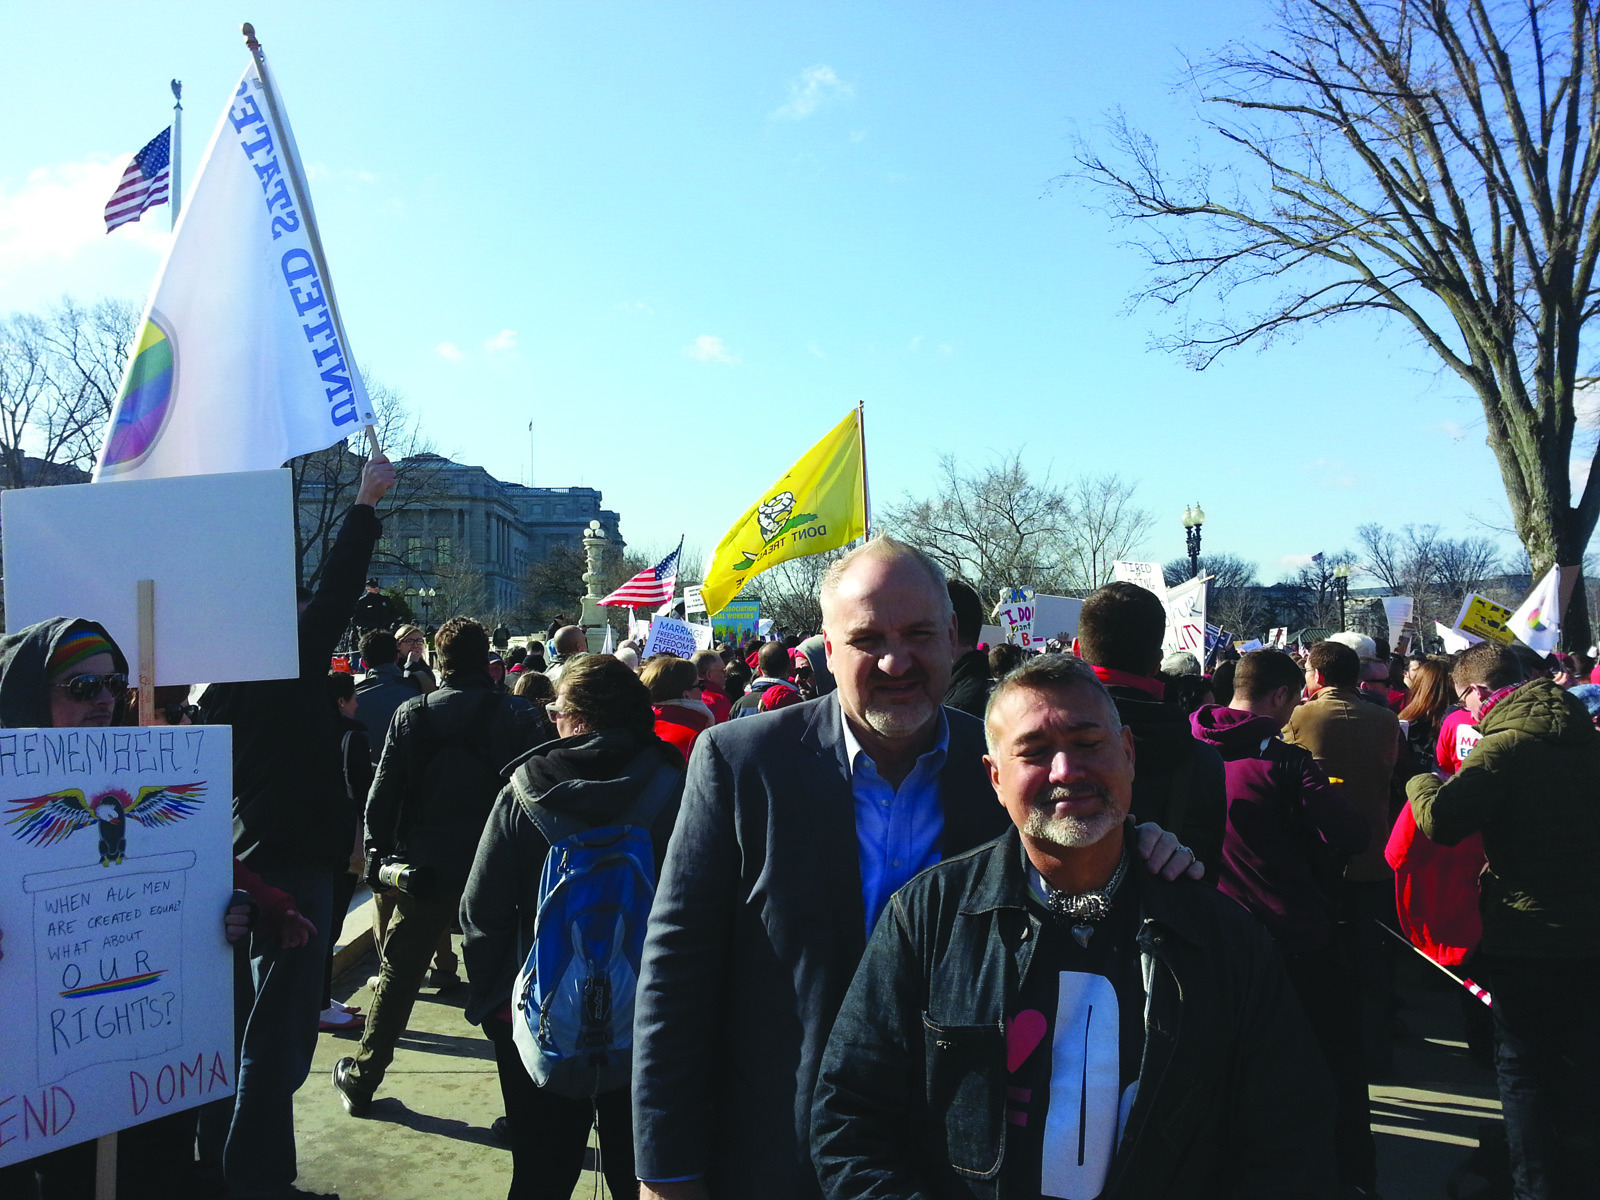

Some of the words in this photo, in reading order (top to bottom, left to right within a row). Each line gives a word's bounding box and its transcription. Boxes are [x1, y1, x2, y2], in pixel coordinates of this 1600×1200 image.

[1121, 562, 1152, 573] TIRED
[655, 636, 688, 650] FREEDOM
[656, 630, 686, 642] FREEDOM
[660, 621, 704, 639] MARRIAGE
[652, 643, 693, 661] EVERYO
[45, 892, 91, 914] WHEN
[106, 887, 136, 902] ALL
[143, 880, 171, 895] MEN
[47, 920, 77, 937] ARE
[88, 909, 141, 929] CREATED
[150, 900, 181, 916] EQUAL?
[47, 939, 92, 961] WHAT
[103, 930, 144, 949] ABOUT
[62, 950, 152, 989] OUR
[51, 991, 175, 1056] RIGHTS?
[0, 1086, 75, 1147] END
[130, 1051, 228, 1116] DOMA
